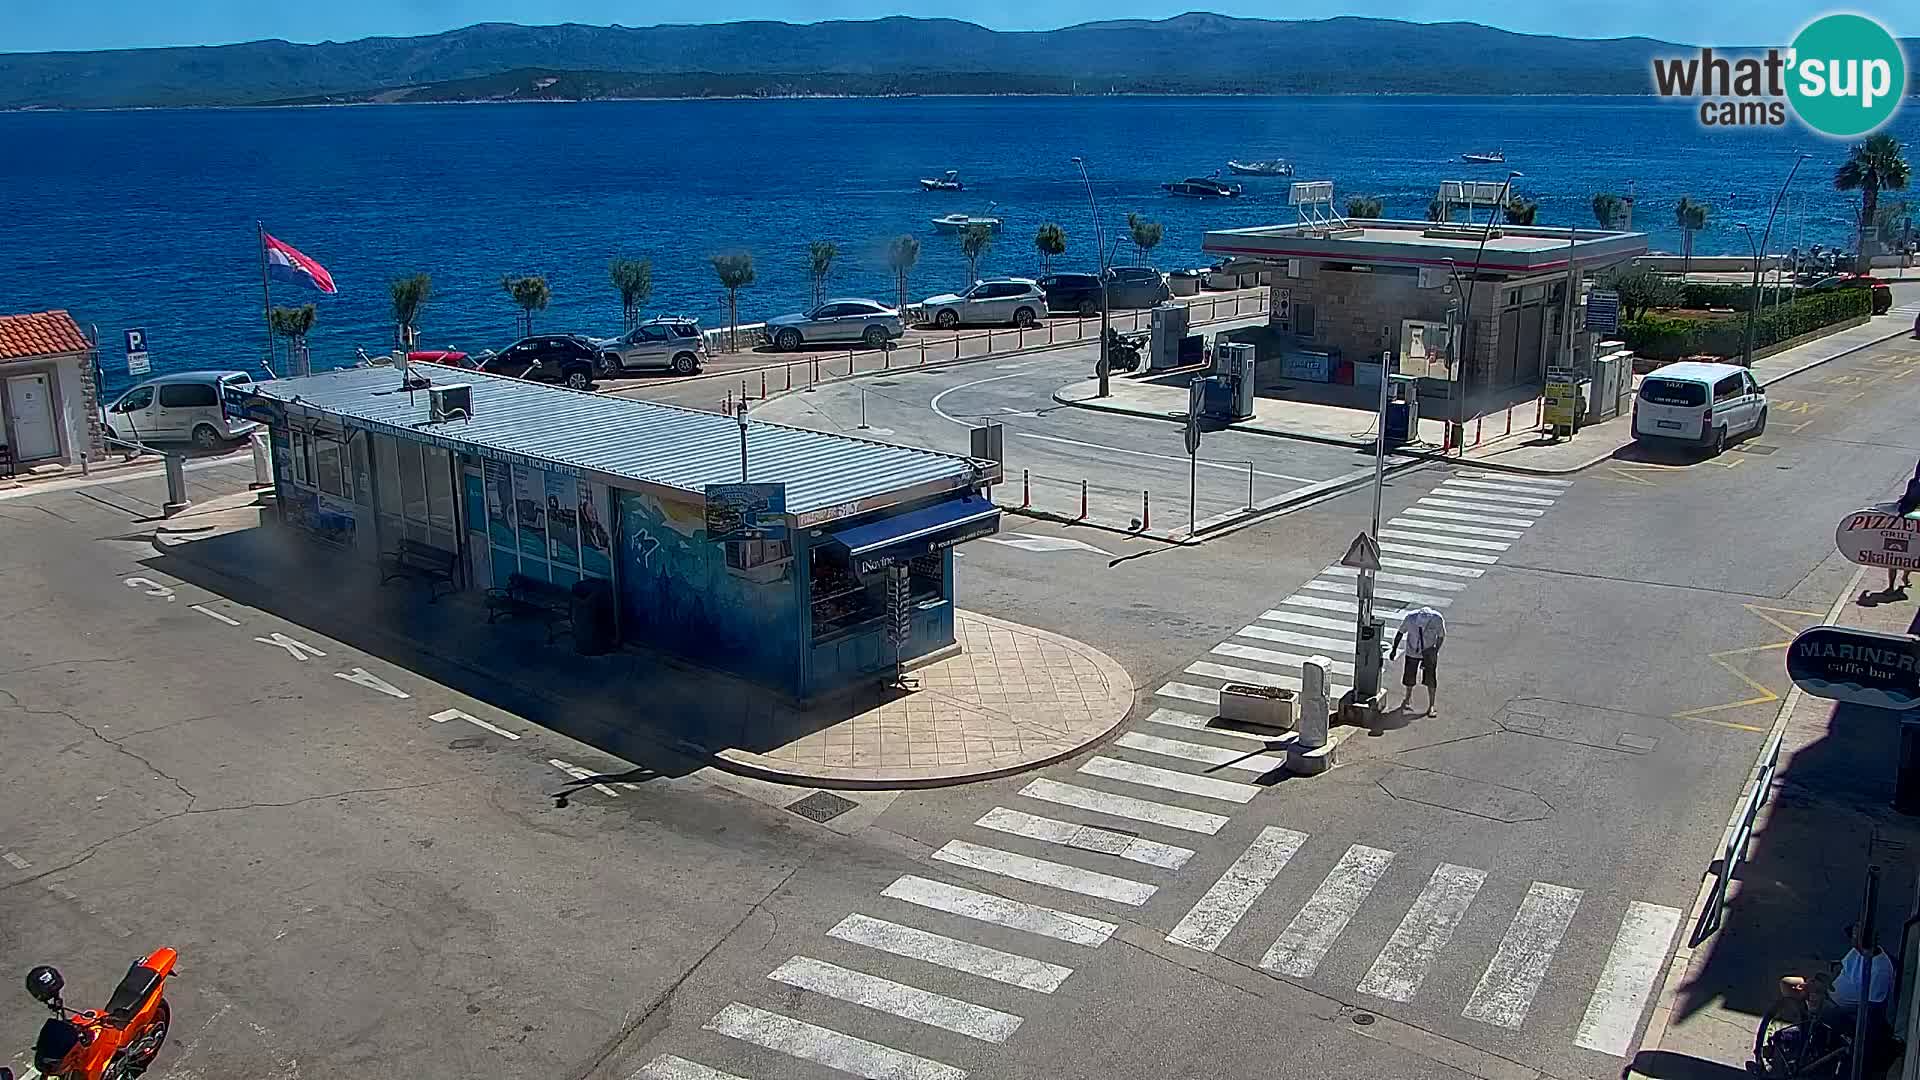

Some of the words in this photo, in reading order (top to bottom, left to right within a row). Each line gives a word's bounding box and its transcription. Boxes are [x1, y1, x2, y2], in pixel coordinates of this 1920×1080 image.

[129, 332, 141, 349] P
[477, 447, 492, 459] BUS
[492, 450, 525, 465] STATION
[527, 458, 552, 472] TICKET
[554, 464, 581, 478] OFFICE
[1827, 661, 1864, 675] caffe
[1869, 665, 1896, 680] bar
